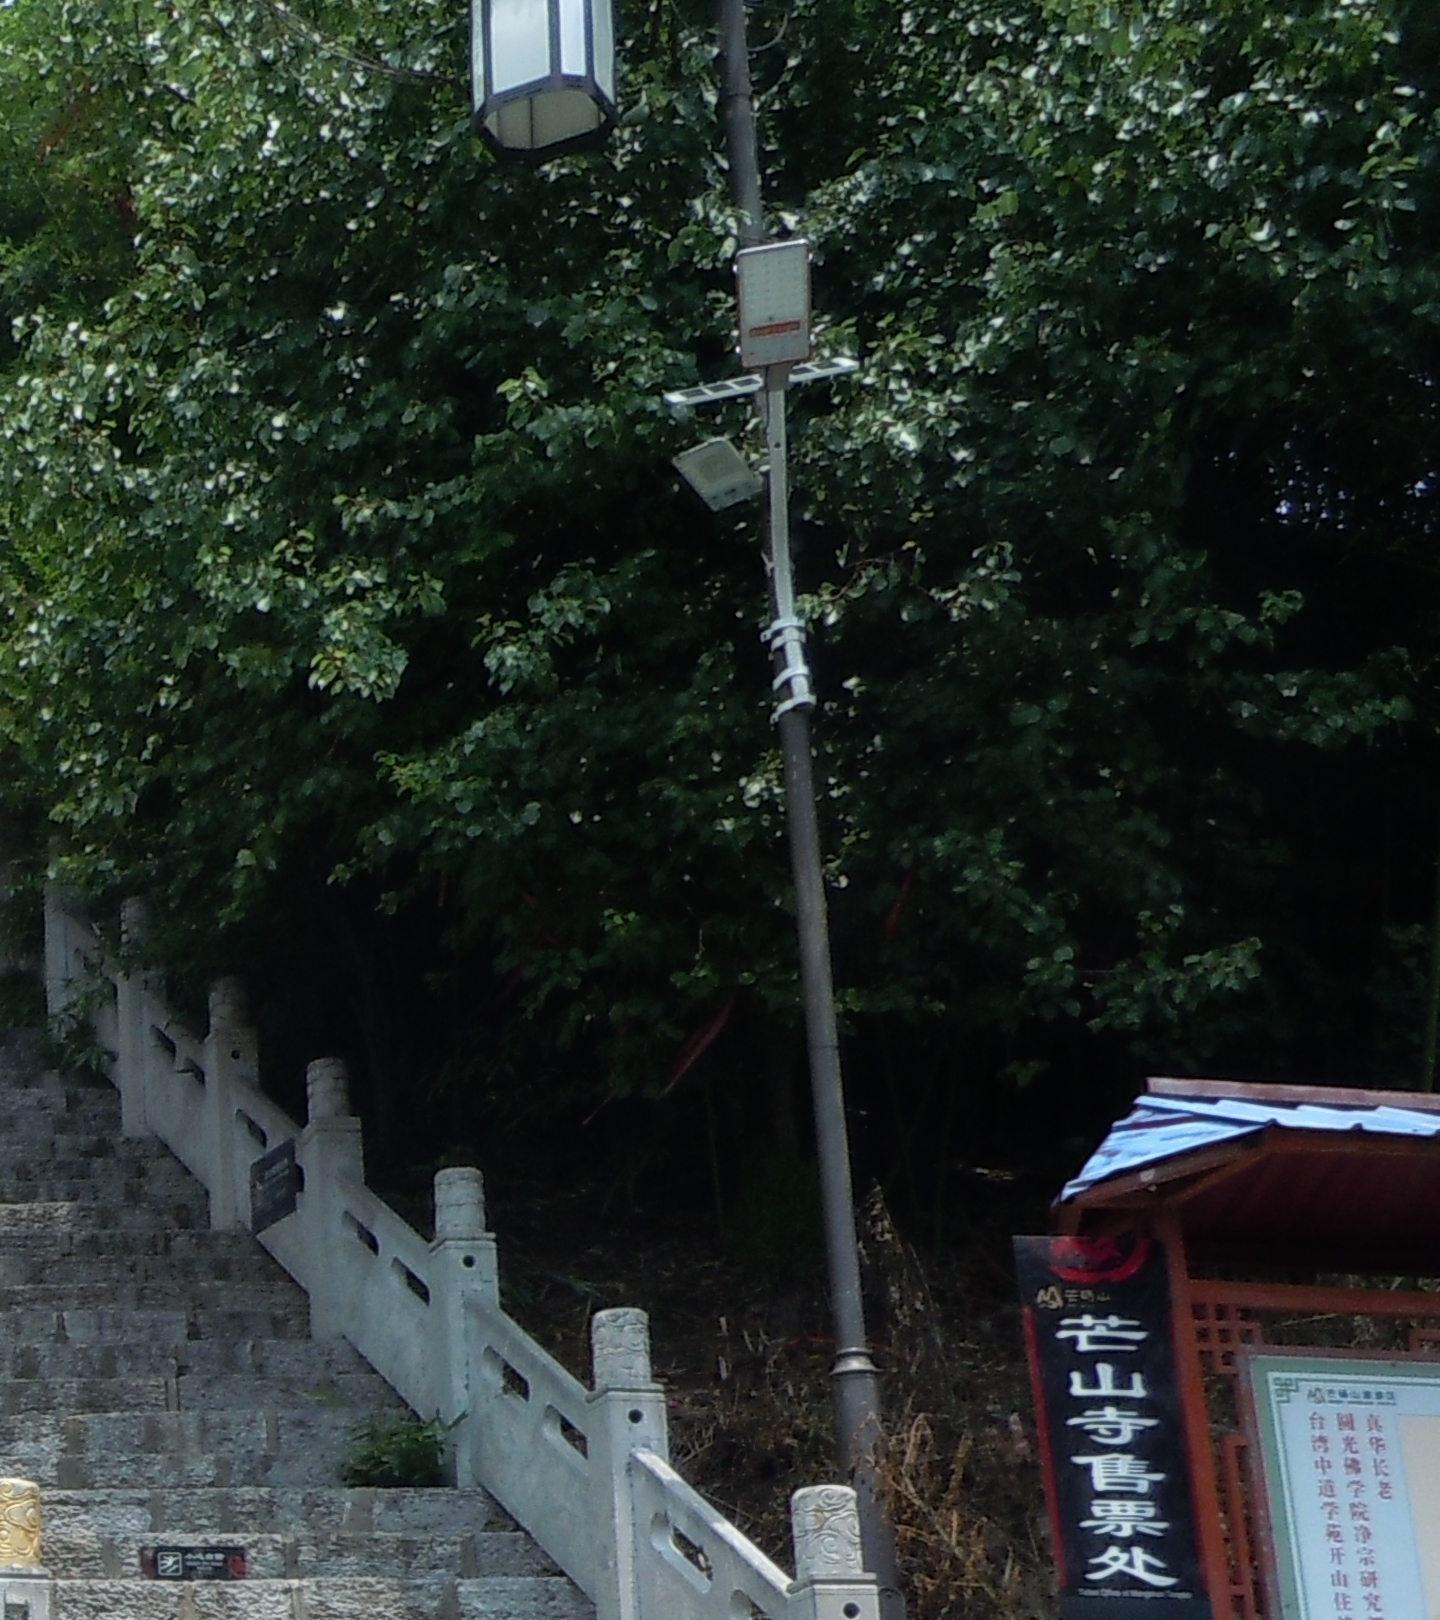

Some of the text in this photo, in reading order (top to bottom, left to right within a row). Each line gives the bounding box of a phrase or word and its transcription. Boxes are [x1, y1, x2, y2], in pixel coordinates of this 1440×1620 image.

[1054, 1313, 1180, 1587] 芒山寺售票处
